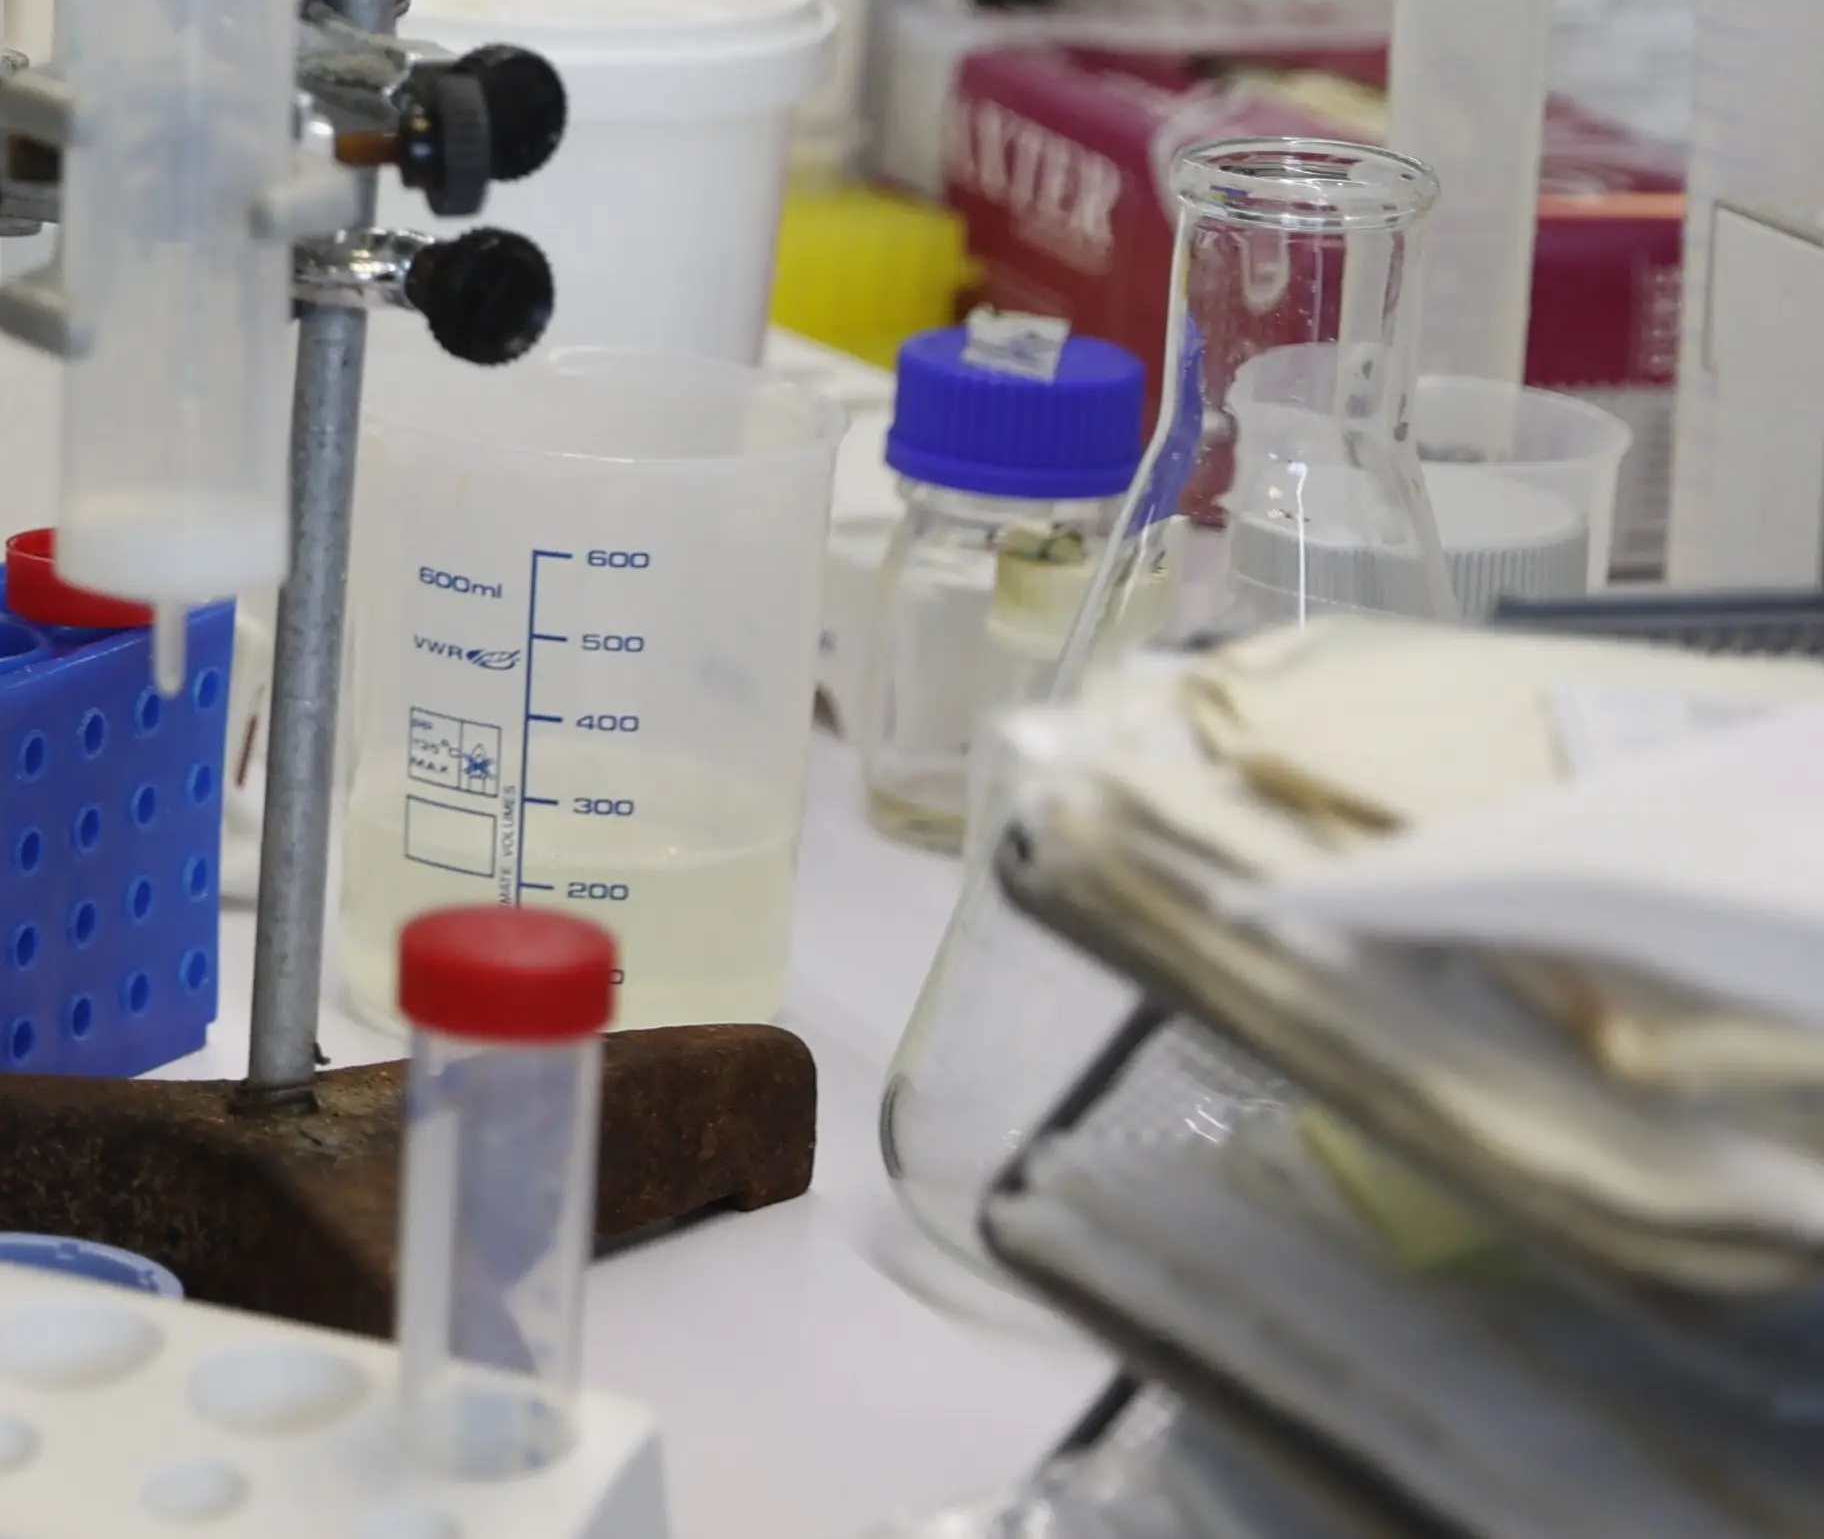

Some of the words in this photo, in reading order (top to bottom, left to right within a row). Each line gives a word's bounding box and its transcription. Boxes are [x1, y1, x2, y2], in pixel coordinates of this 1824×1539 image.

[586, 550, 650, 569] 600
[418, 566, 503, 599] 600ml
[413, 635, 464, 660] VWR
[580, 633, 645, 653] 500
[575, 714, 639, 733] 400
[572, 798, 635, 817] 300
[501, 784, 516, 857] VOLUMES
[566, 882, 630, 901] 200
